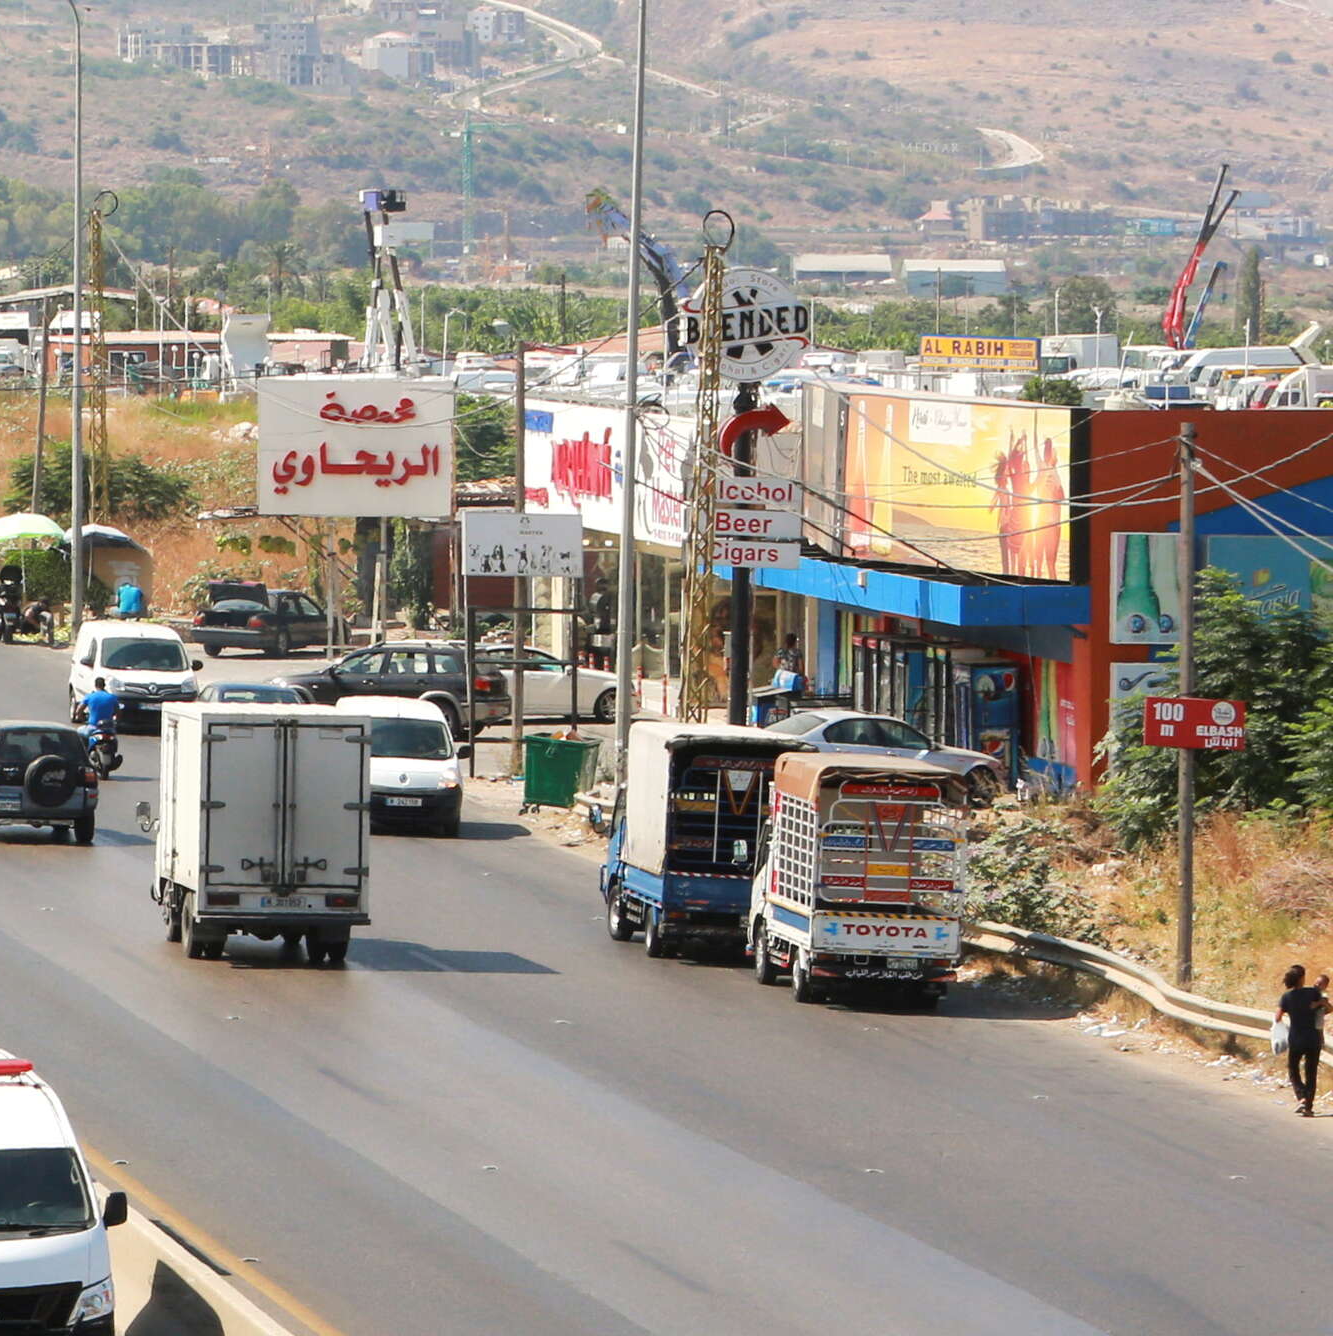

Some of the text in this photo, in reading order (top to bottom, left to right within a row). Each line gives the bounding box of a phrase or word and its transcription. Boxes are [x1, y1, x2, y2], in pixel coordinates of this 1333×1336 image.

[686, 305, 809, 344] BENDED
[924, 339, 942, 354] AL
[952, 340, 1004, 356] RABIH
[319, 391, 416, 424] محمصة
[273, 442, 439, 495] الريحاوي
[902, 466, 918, 483] The
[920, 471, 941, 485] most
[715, 513, 773, 533] Beer
[711, 542, 779, 565] Cigars
[1153, 702, 1184, 721] 100
[1196, 725, 1243, 737] ELBASH
[843, 924, 928, 938] TOYOTA
